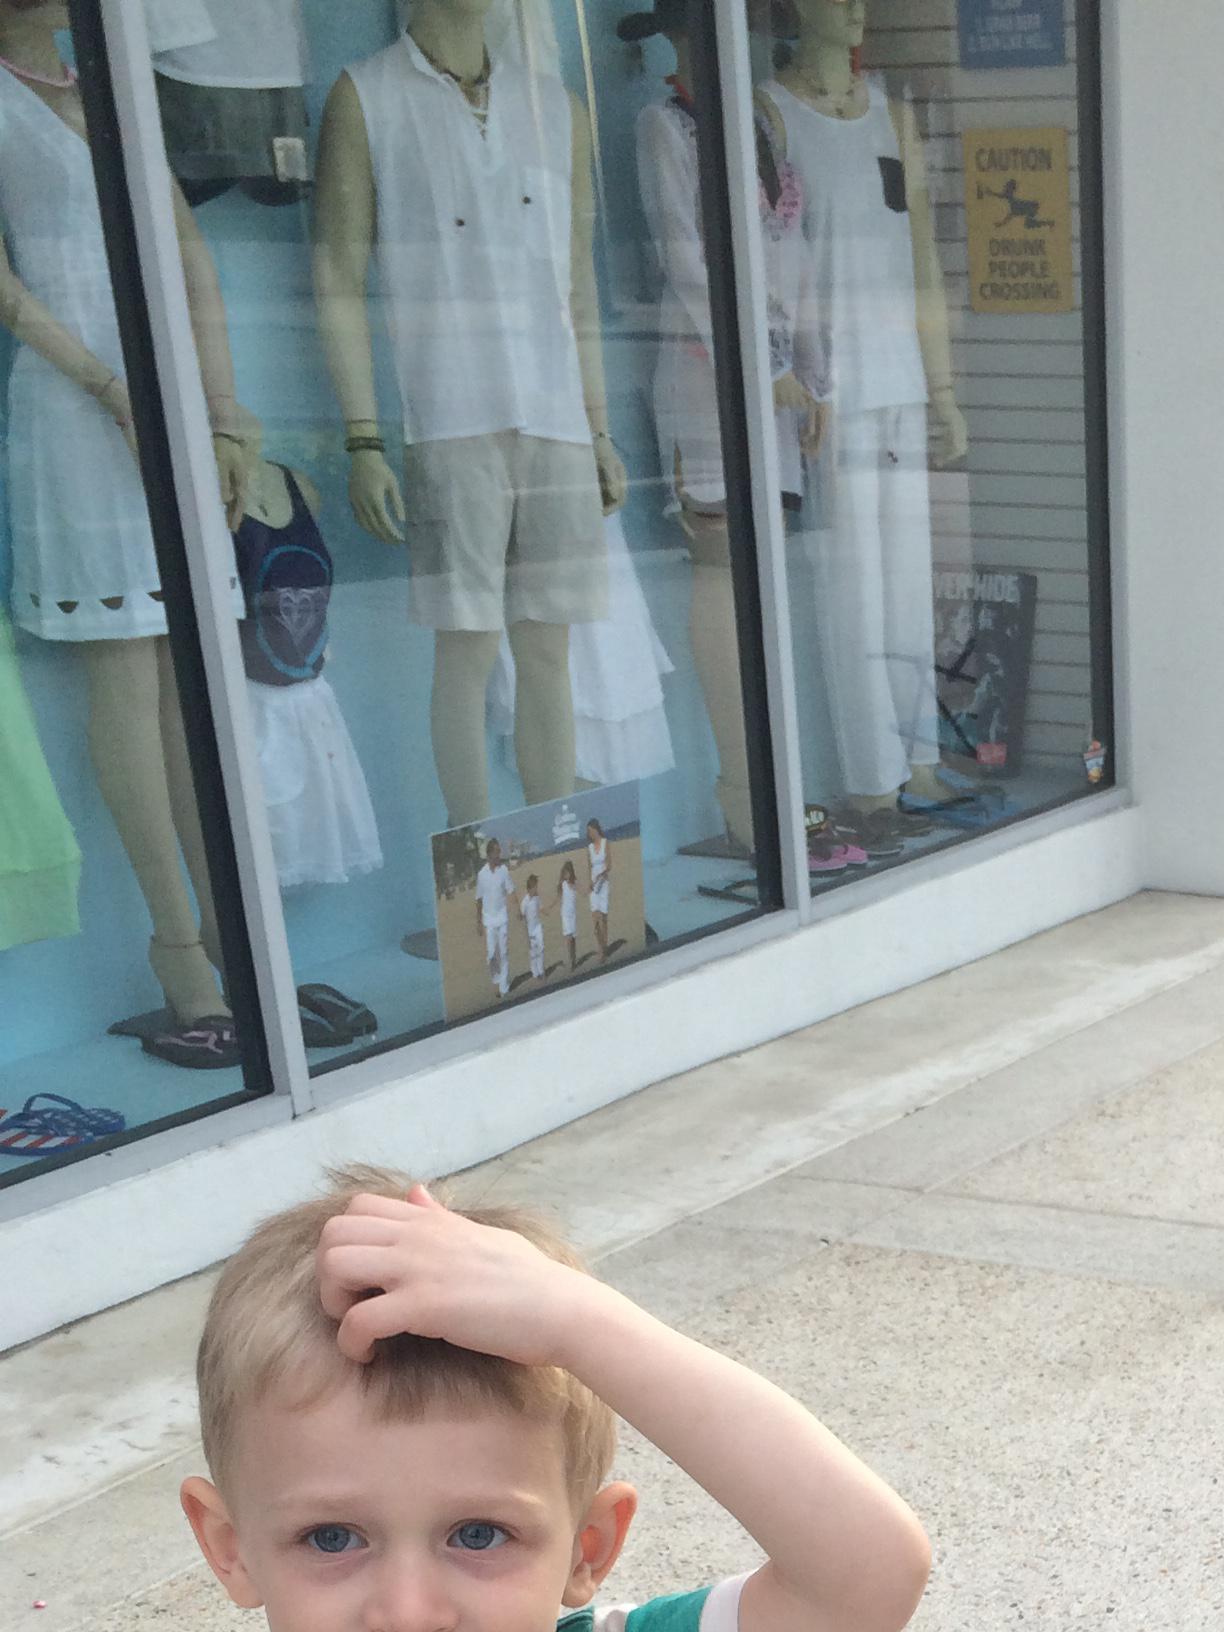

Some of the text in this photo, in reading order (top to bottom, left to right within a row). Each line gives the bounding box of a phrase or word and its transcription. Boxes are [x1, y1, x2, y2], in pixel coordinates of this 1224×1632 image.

[975, 147, 1053, 173] CAUTION
[989, 239, 1045, 257] DRUNK
[988, 260, 1050, 278] PEOPLE
[979, 281, 1061, 301] CROSSING
